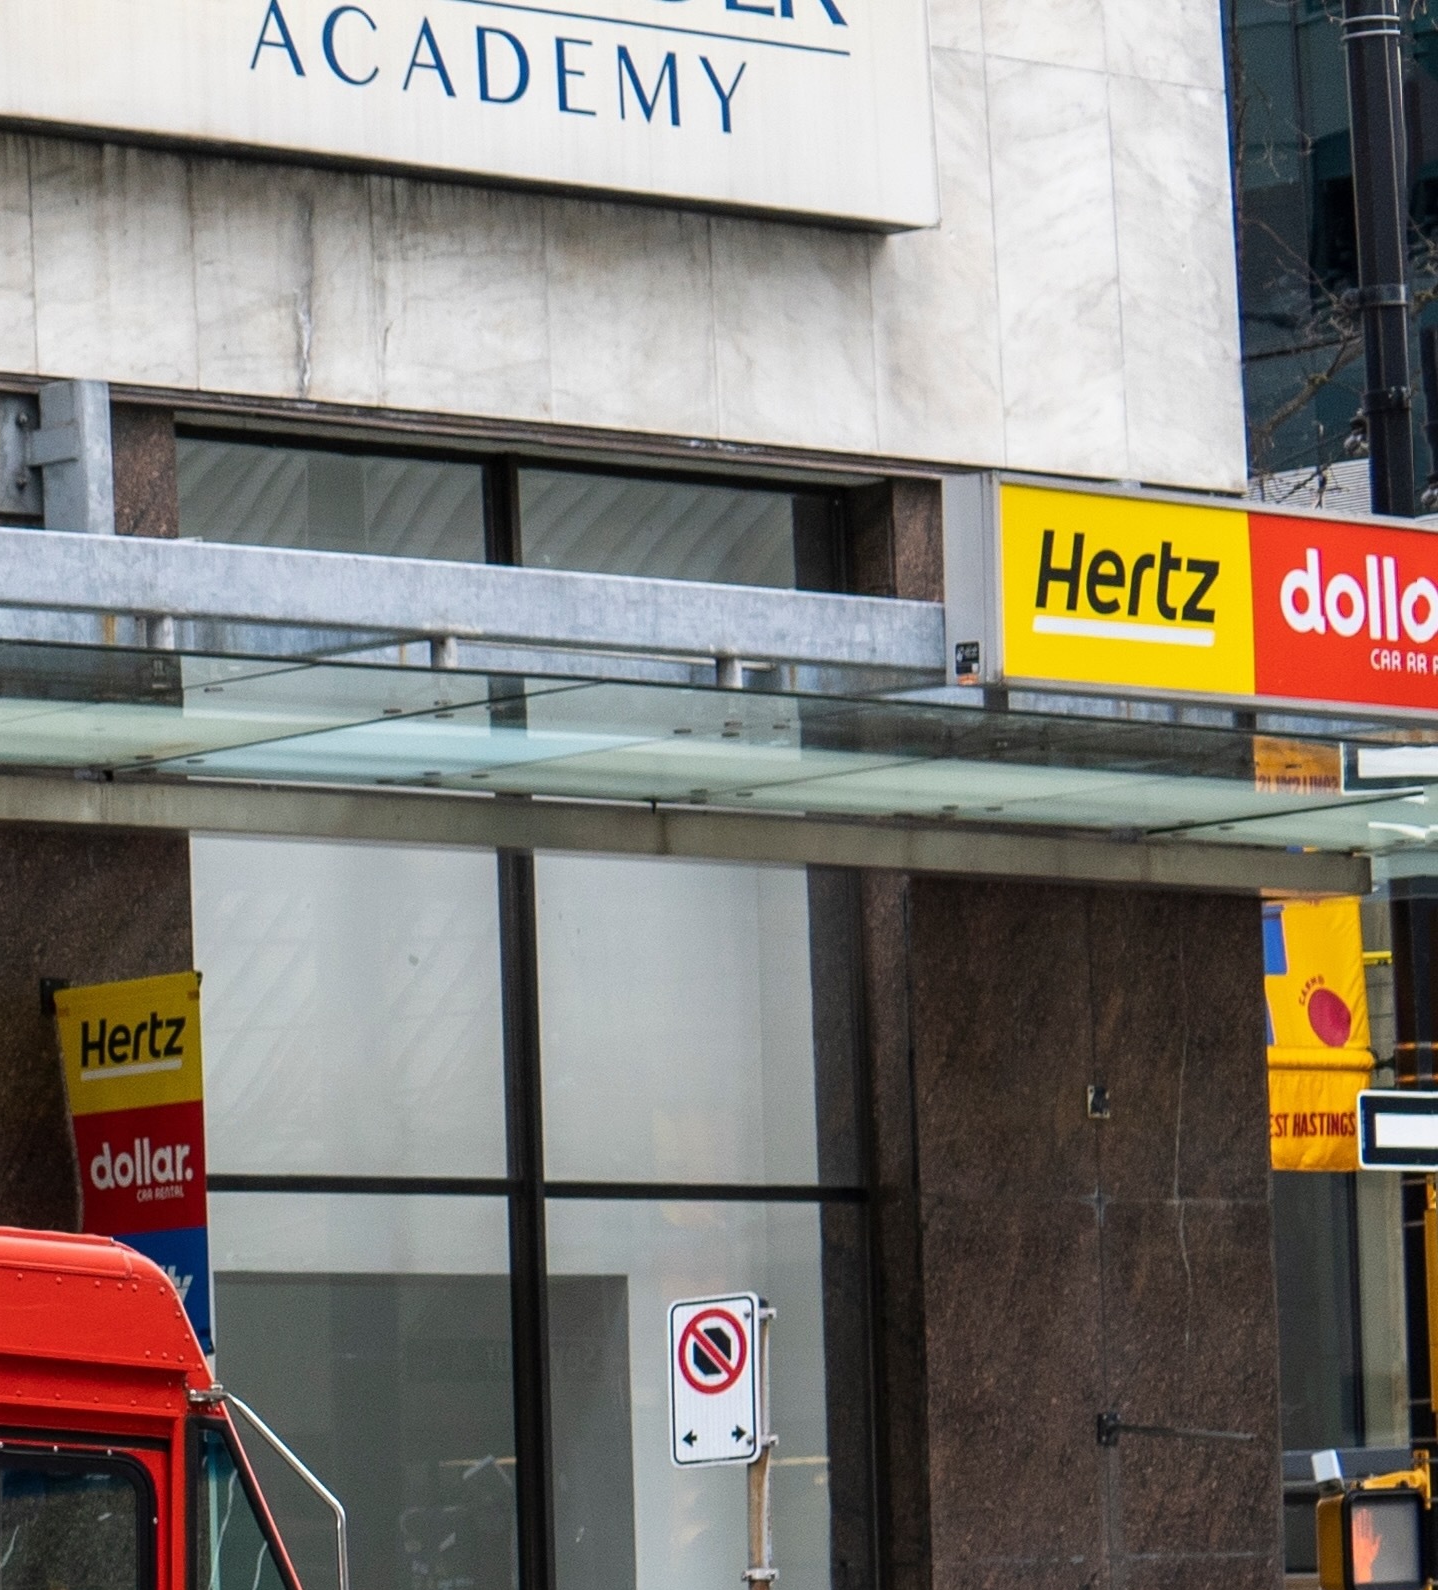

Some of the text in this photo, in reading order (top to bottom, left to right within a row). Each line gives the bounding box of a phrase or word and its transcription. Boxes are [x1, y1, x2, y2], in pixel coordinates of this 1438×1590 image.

[251, 0, 746, 133] ACADEMY
[1035, 528, 1221, 624] Hertz
[1370, 648, 1402, 671] CAR
[80, 1011, 186, 1068] Hertz
[1293, 1109, 1356, 1138] HASTINGS
[90, 1137, 194, 1191] dollar.
